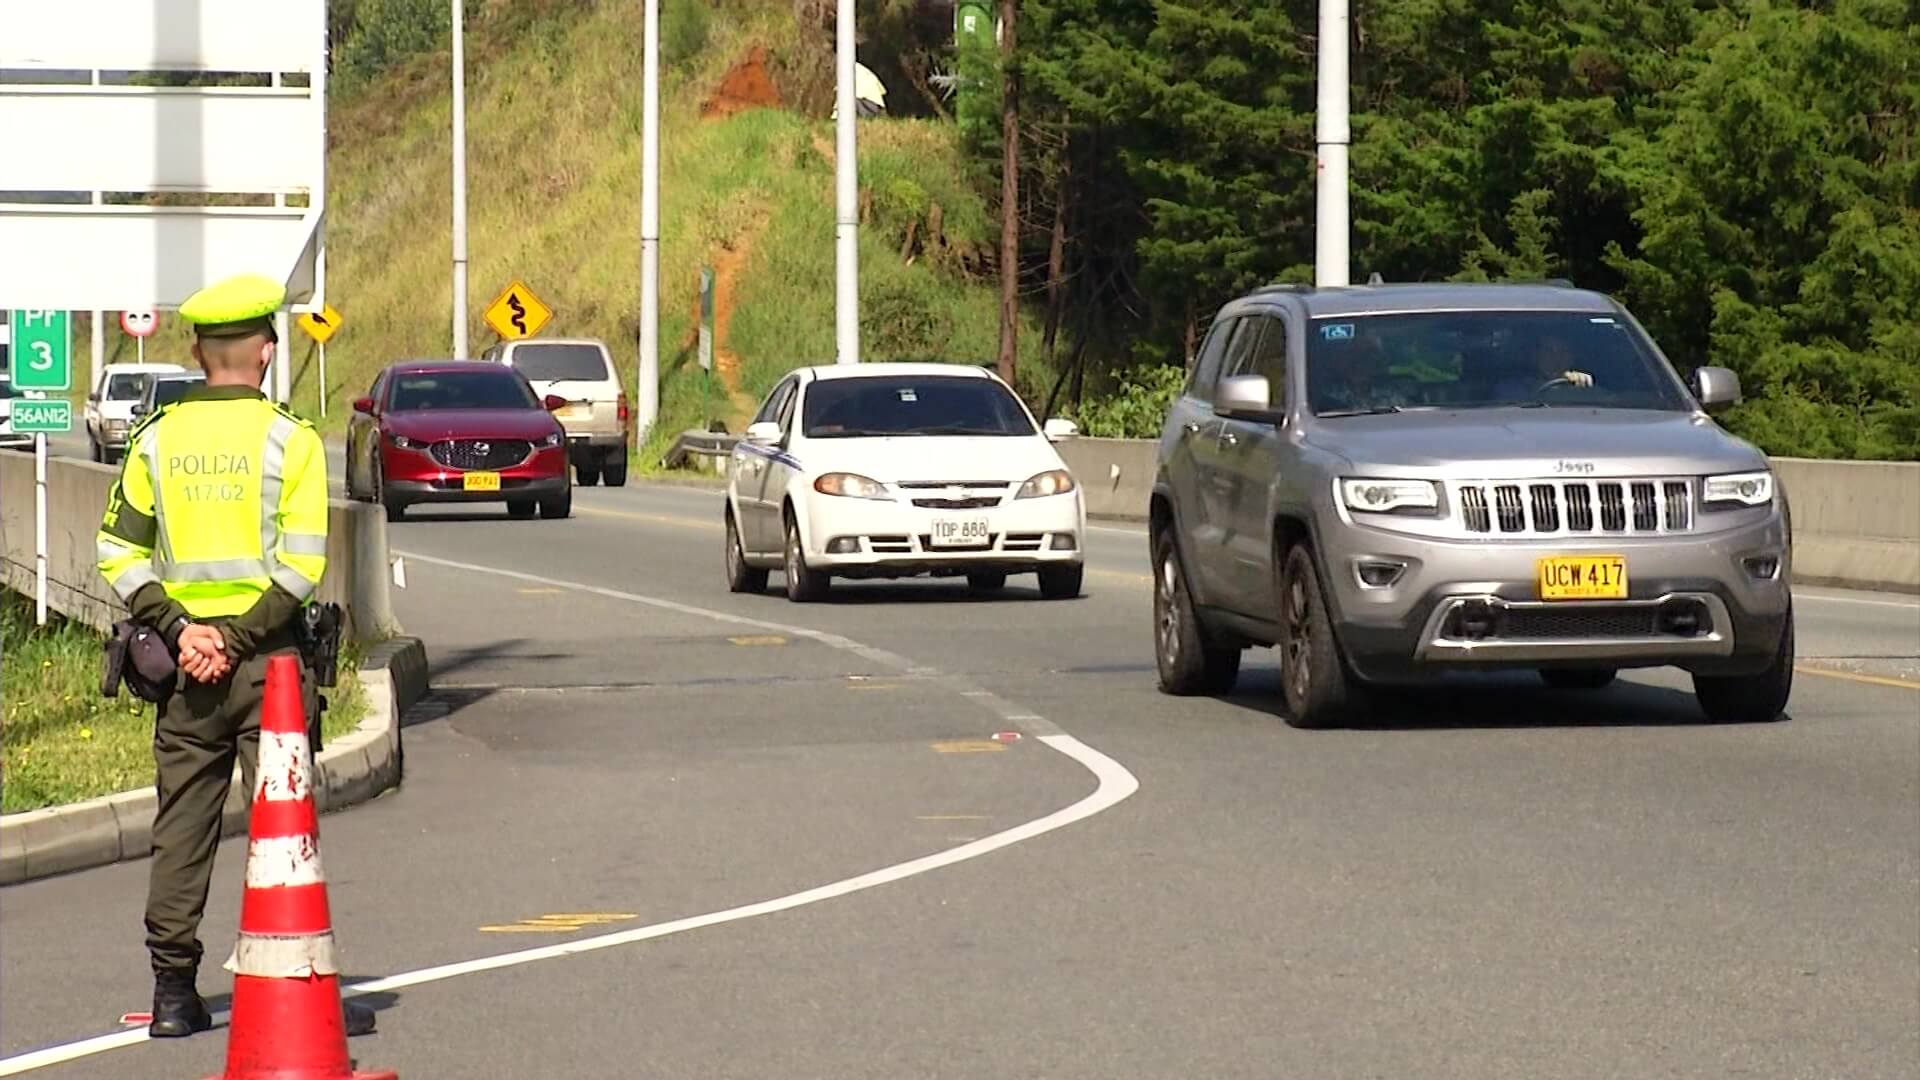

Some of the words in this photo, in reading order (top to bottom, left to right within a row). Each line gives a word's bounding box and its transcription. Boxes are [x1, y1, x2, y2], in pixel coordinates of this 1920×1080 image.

[29, 341, 53, 370] 3
[1545, 564, 1581, 587] UCW
[1588, 564, 1622, 586] 417
